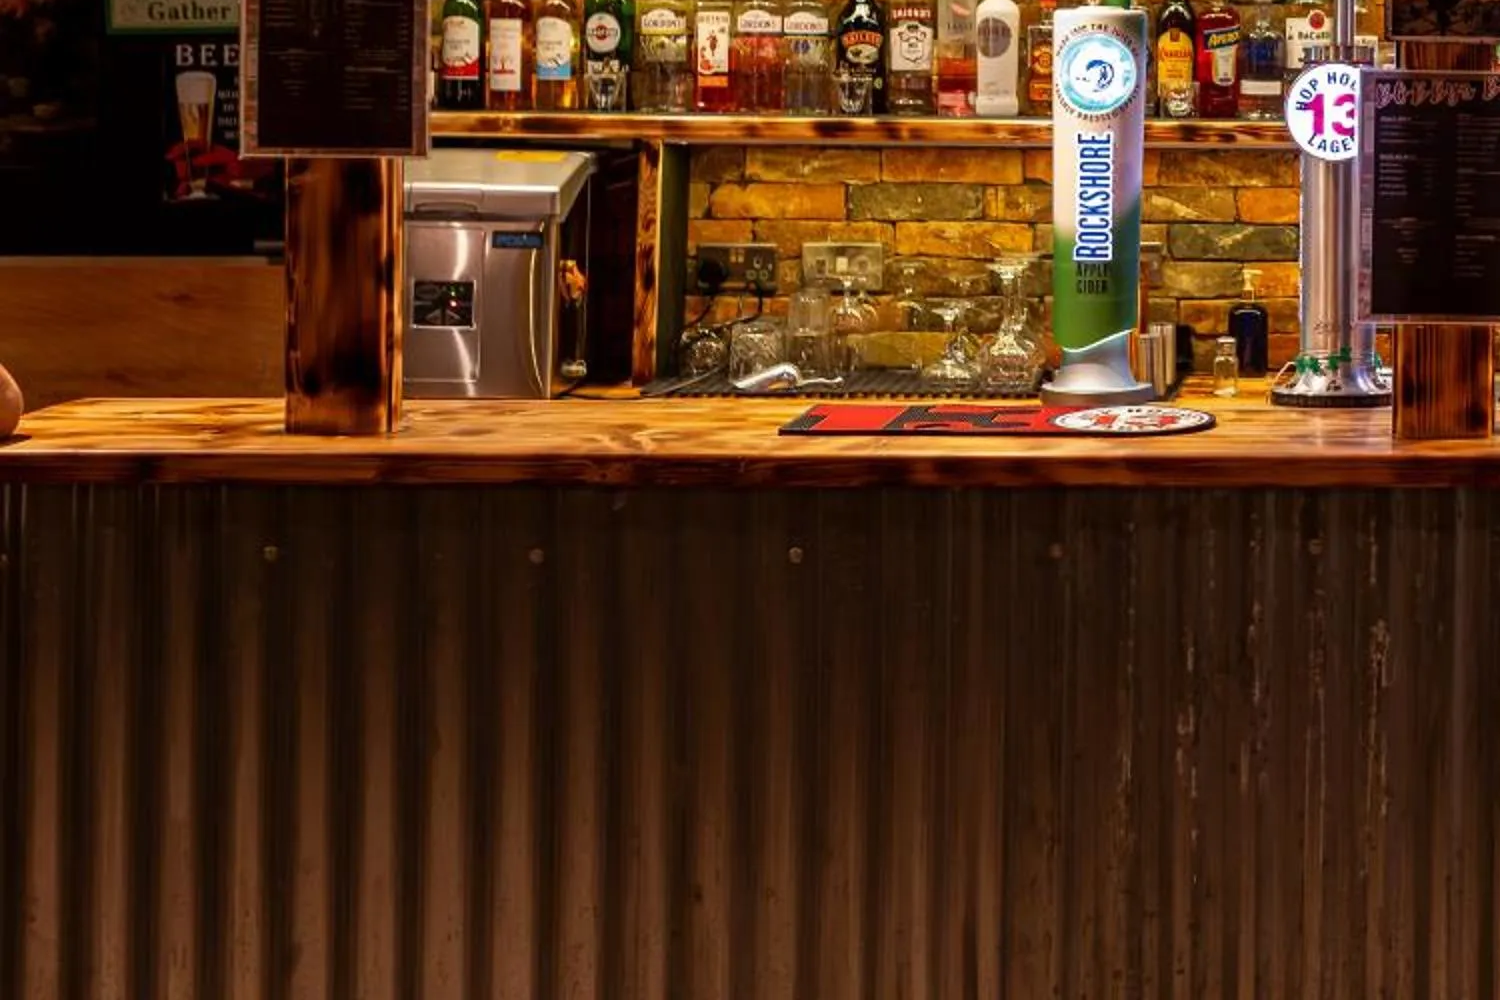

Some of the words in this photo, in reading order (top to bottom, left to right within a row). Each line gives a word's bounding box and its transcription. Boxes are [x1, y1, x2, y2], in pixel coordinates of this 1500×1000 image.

[148, 1, 232, 21] Gather
[175, 43, 240, 67] BEE
[1295, 77, 1320, 112] HOP
[1304, 93, 1357, 137] 13
[1307, 132, 1356, 154] LAGE
[1077, 132, 1112, 260] ROCKSHORE
[1076, 262, 1108, 278] APPLE
[1076, 278, 1109, 295] CIDER
